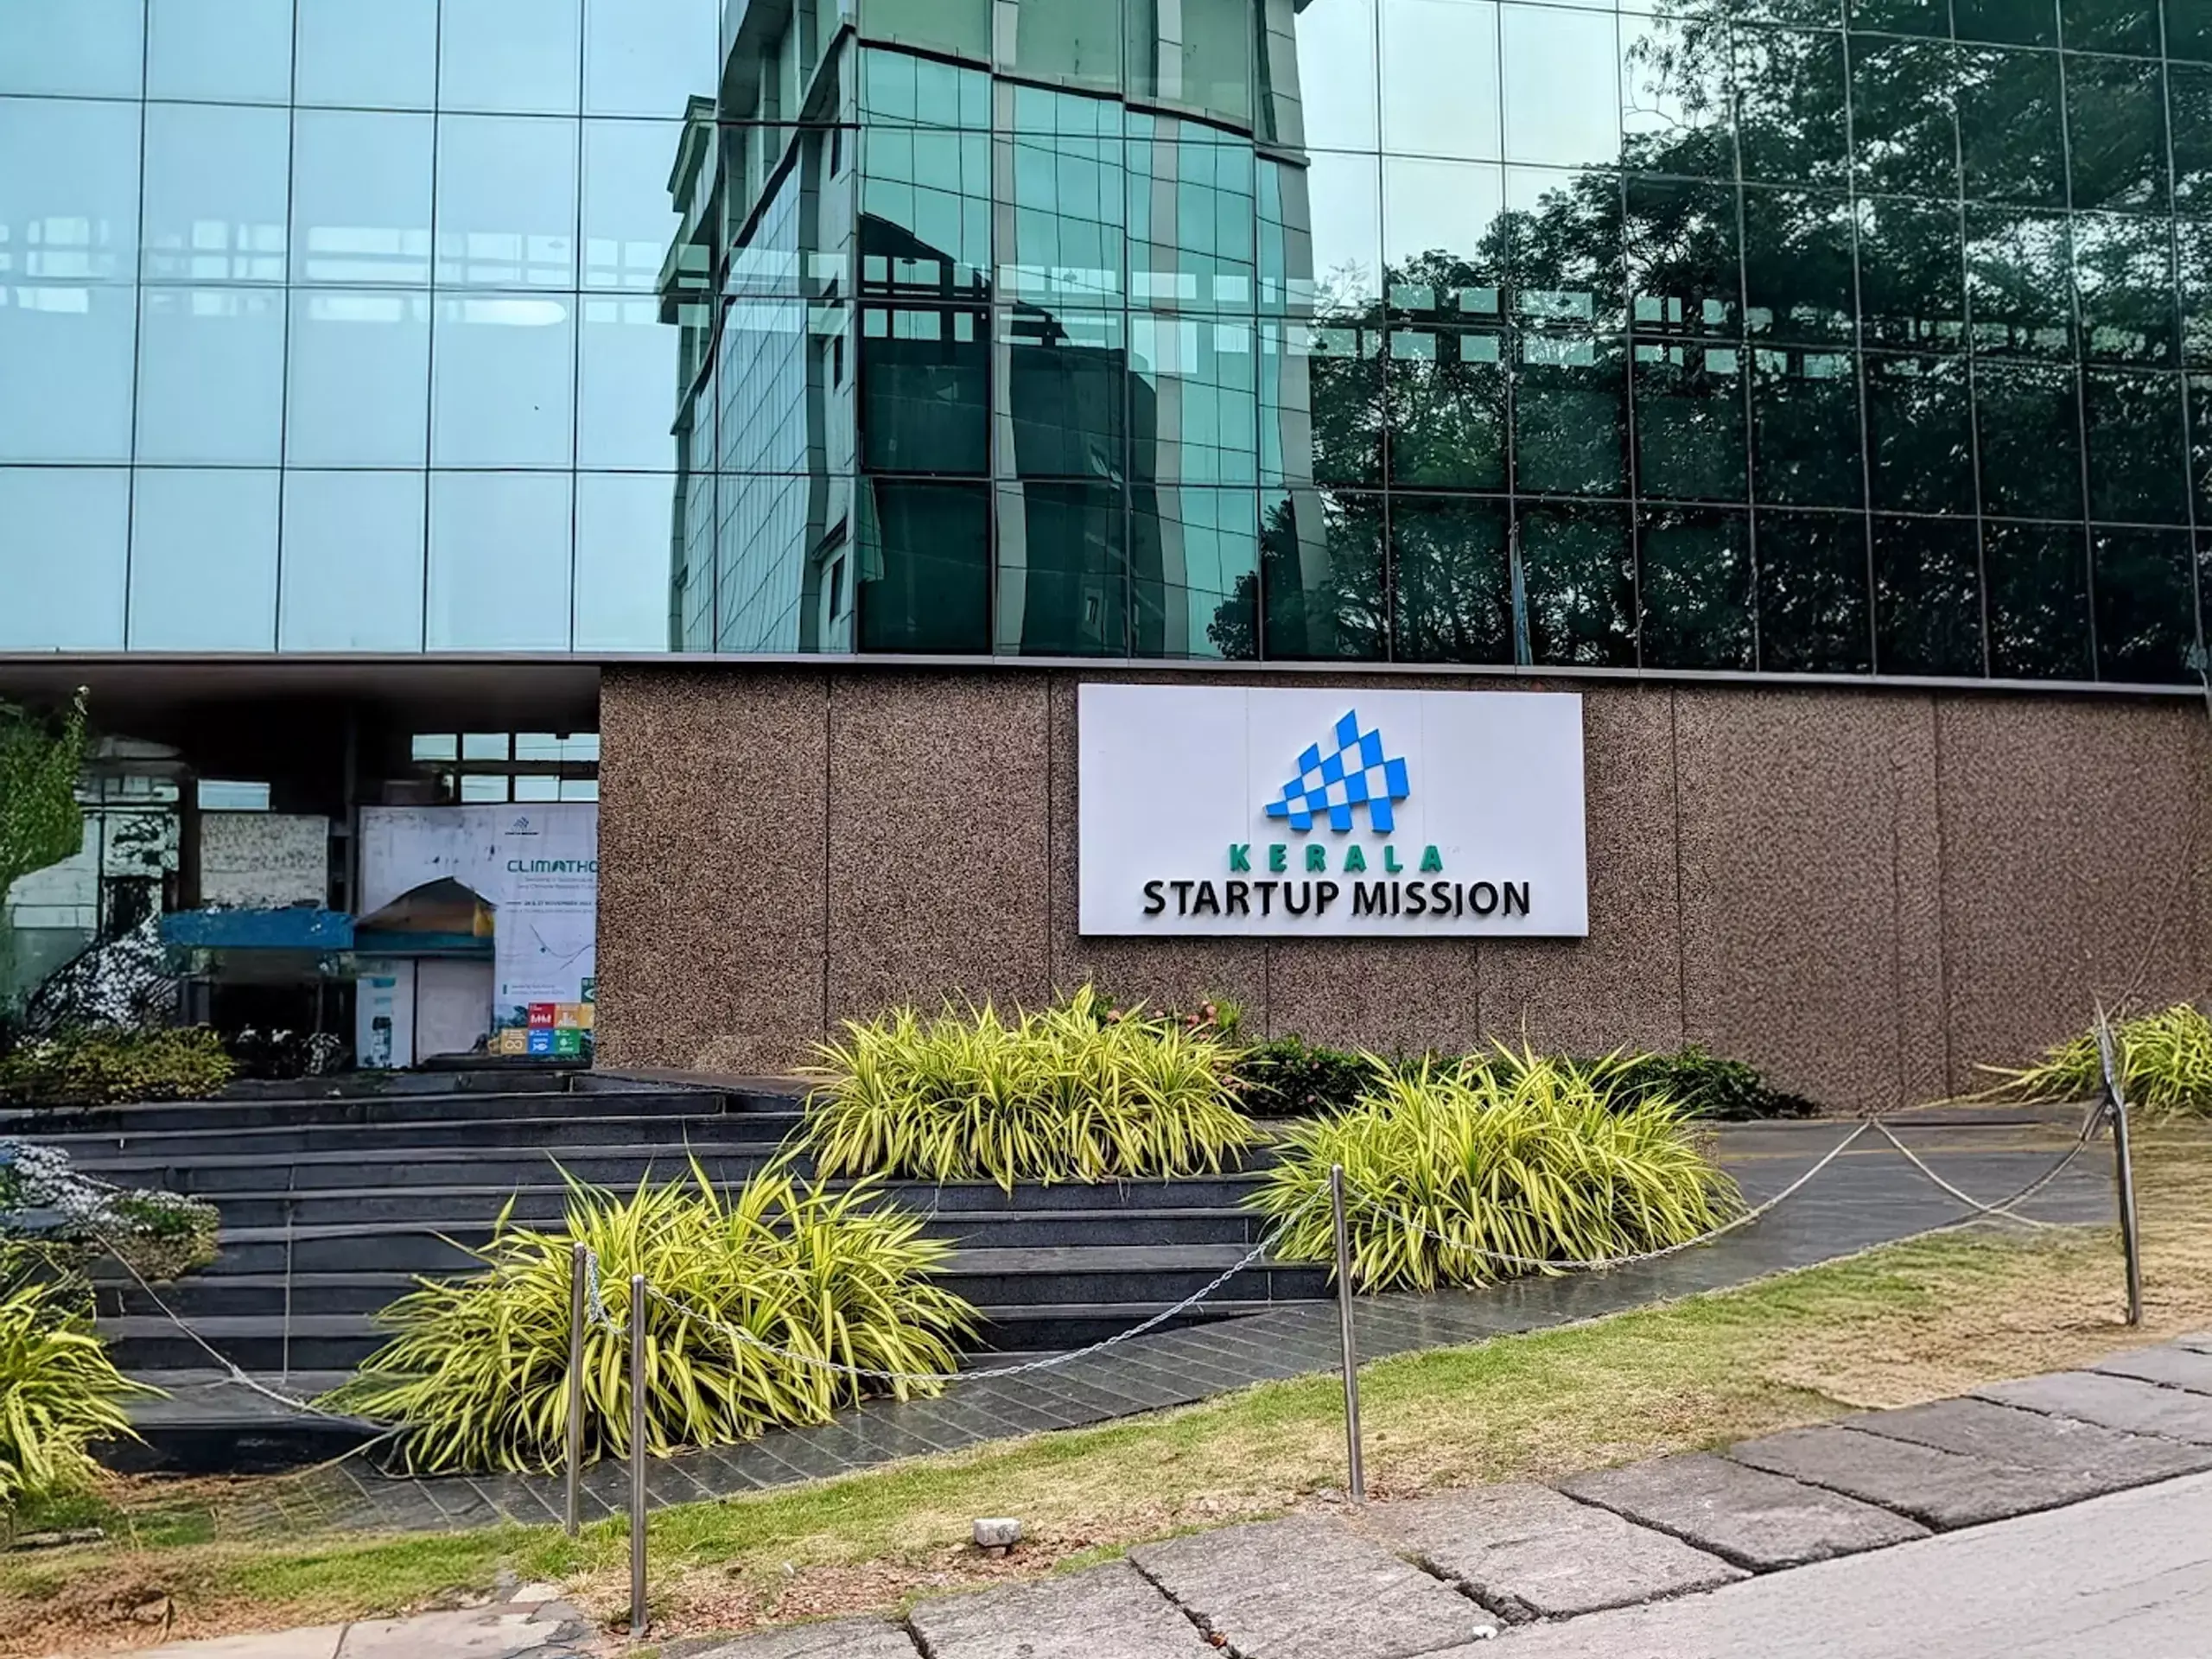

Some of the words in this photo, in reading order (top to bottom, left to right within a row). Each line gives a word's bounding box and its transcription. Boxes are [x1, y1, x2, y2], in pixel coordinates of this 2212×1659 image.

[1229, 843, 1444, 873] KERALA
[1143, 880, 1340, 916] STARTUP
[1352, 881, 1532, 917] MISSION
